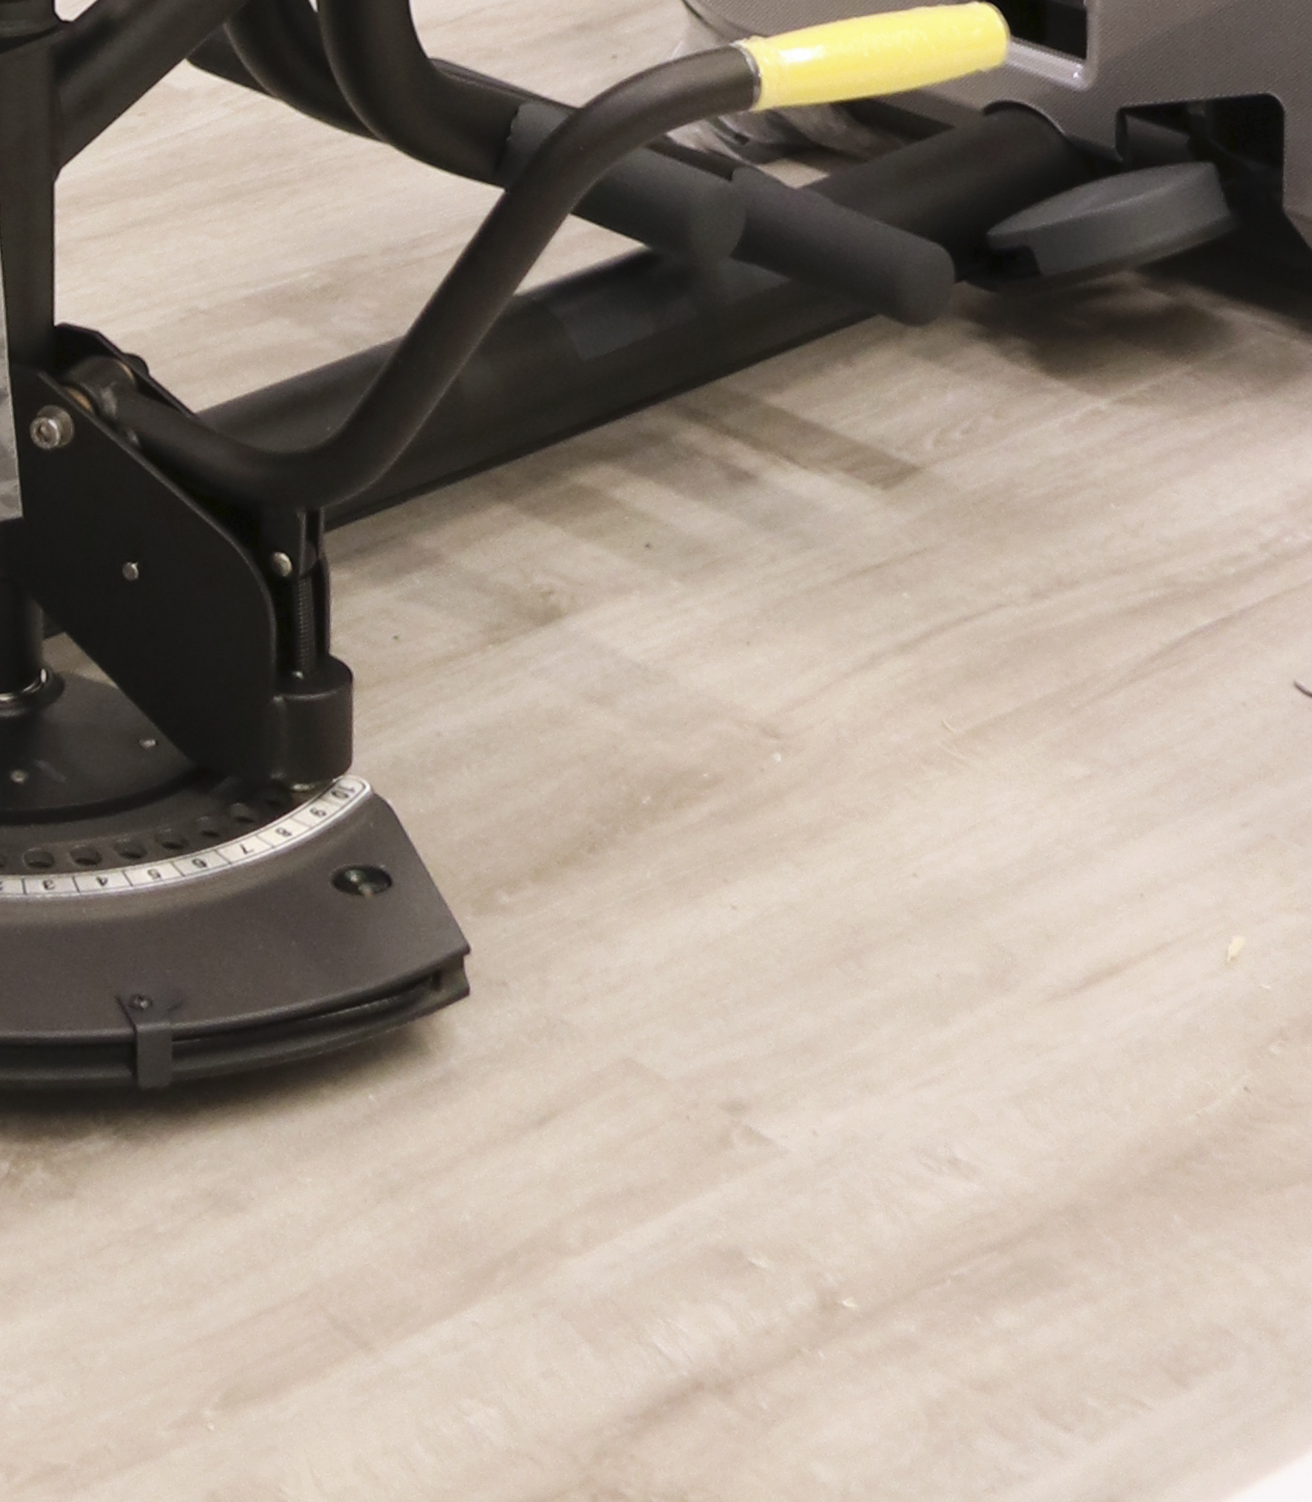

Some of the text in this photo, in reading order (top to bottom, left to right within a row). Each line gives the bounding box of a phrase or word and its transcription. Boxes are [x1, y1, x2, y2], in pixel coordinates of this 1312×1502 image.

[42, 880, 56, 890] 3
[97, 877, 109, 887] 4
[240, 844, 254, 855] 7
